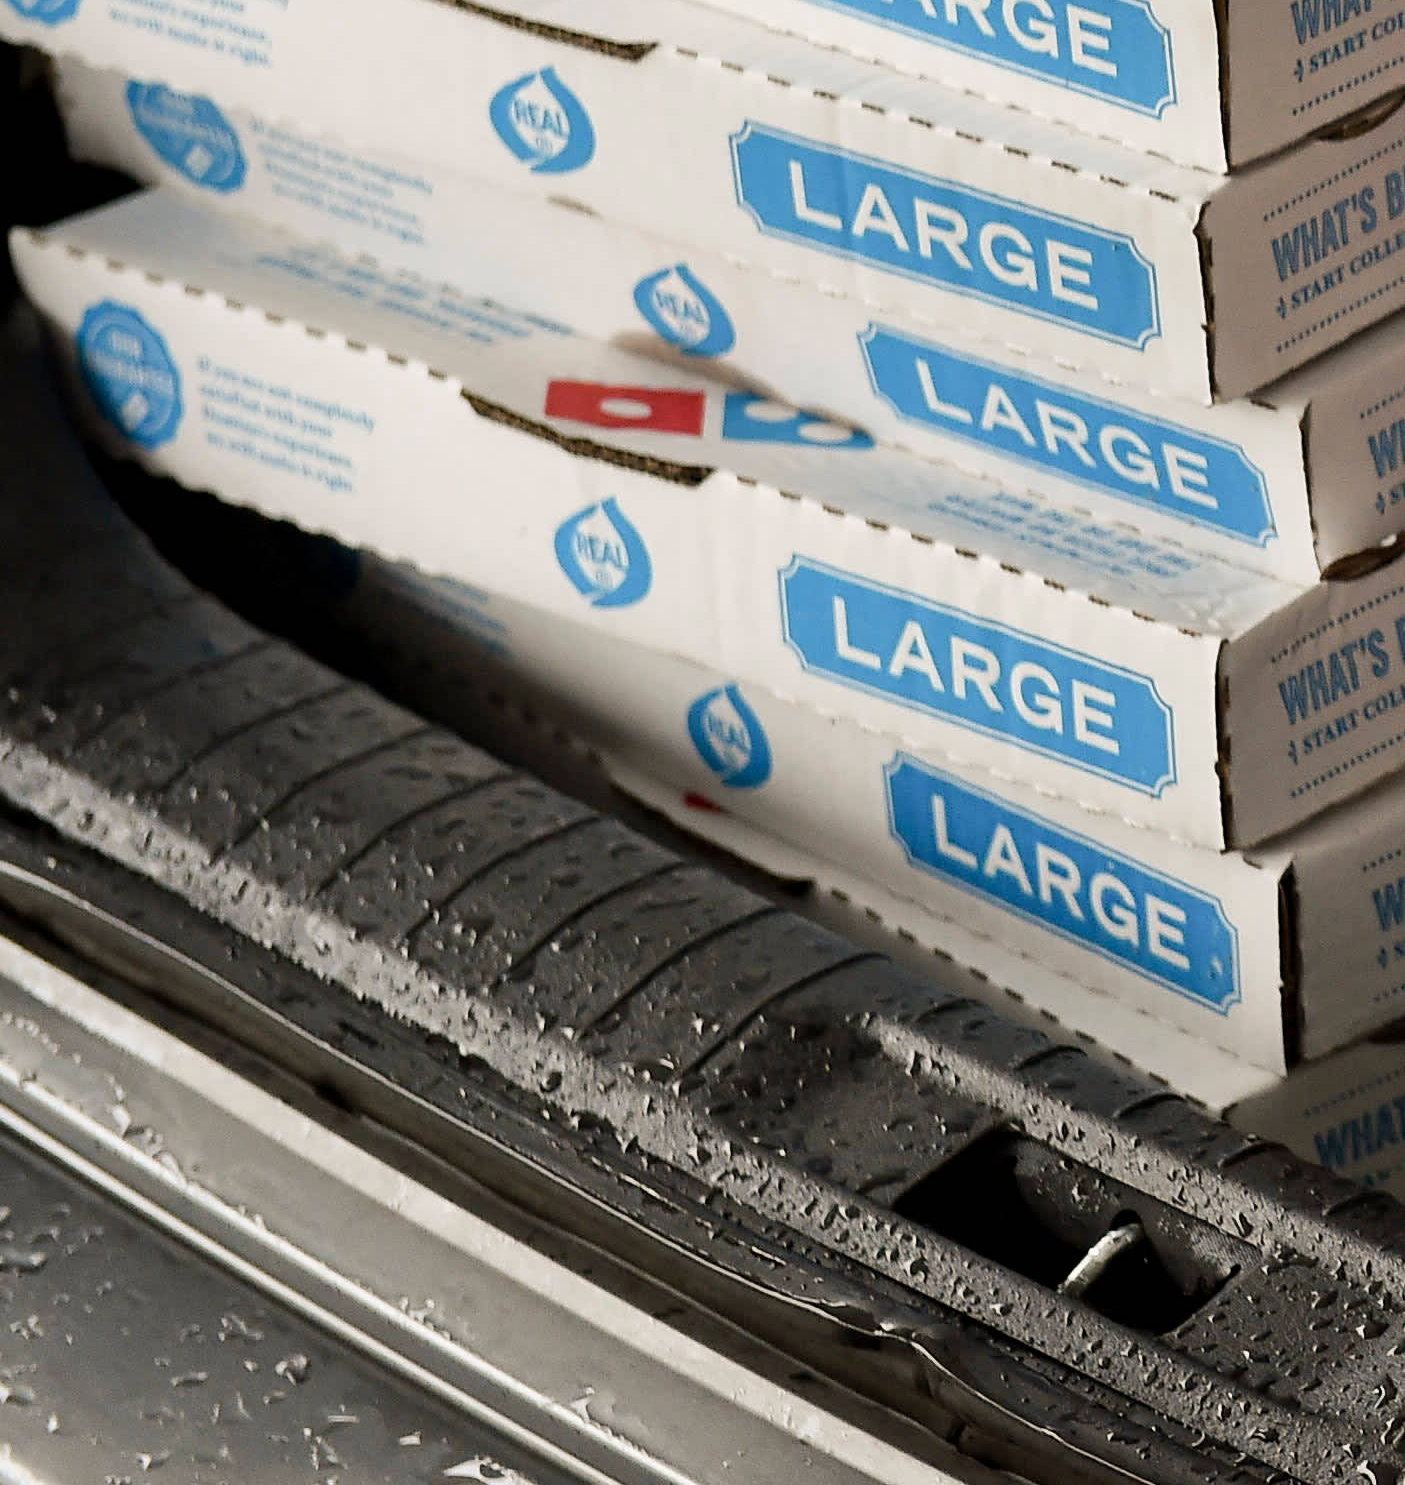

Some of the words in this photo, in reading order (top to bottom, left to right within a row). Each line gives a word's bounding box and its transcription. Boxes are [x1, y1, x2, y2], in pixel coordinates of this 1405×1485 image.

[789, 163, 1098, 308] LARGE
[916, 360, 1218, 509] LARGE
[834, 594, 1120, 757] LARGE
[932, 795, 1191, 970] LARGE
